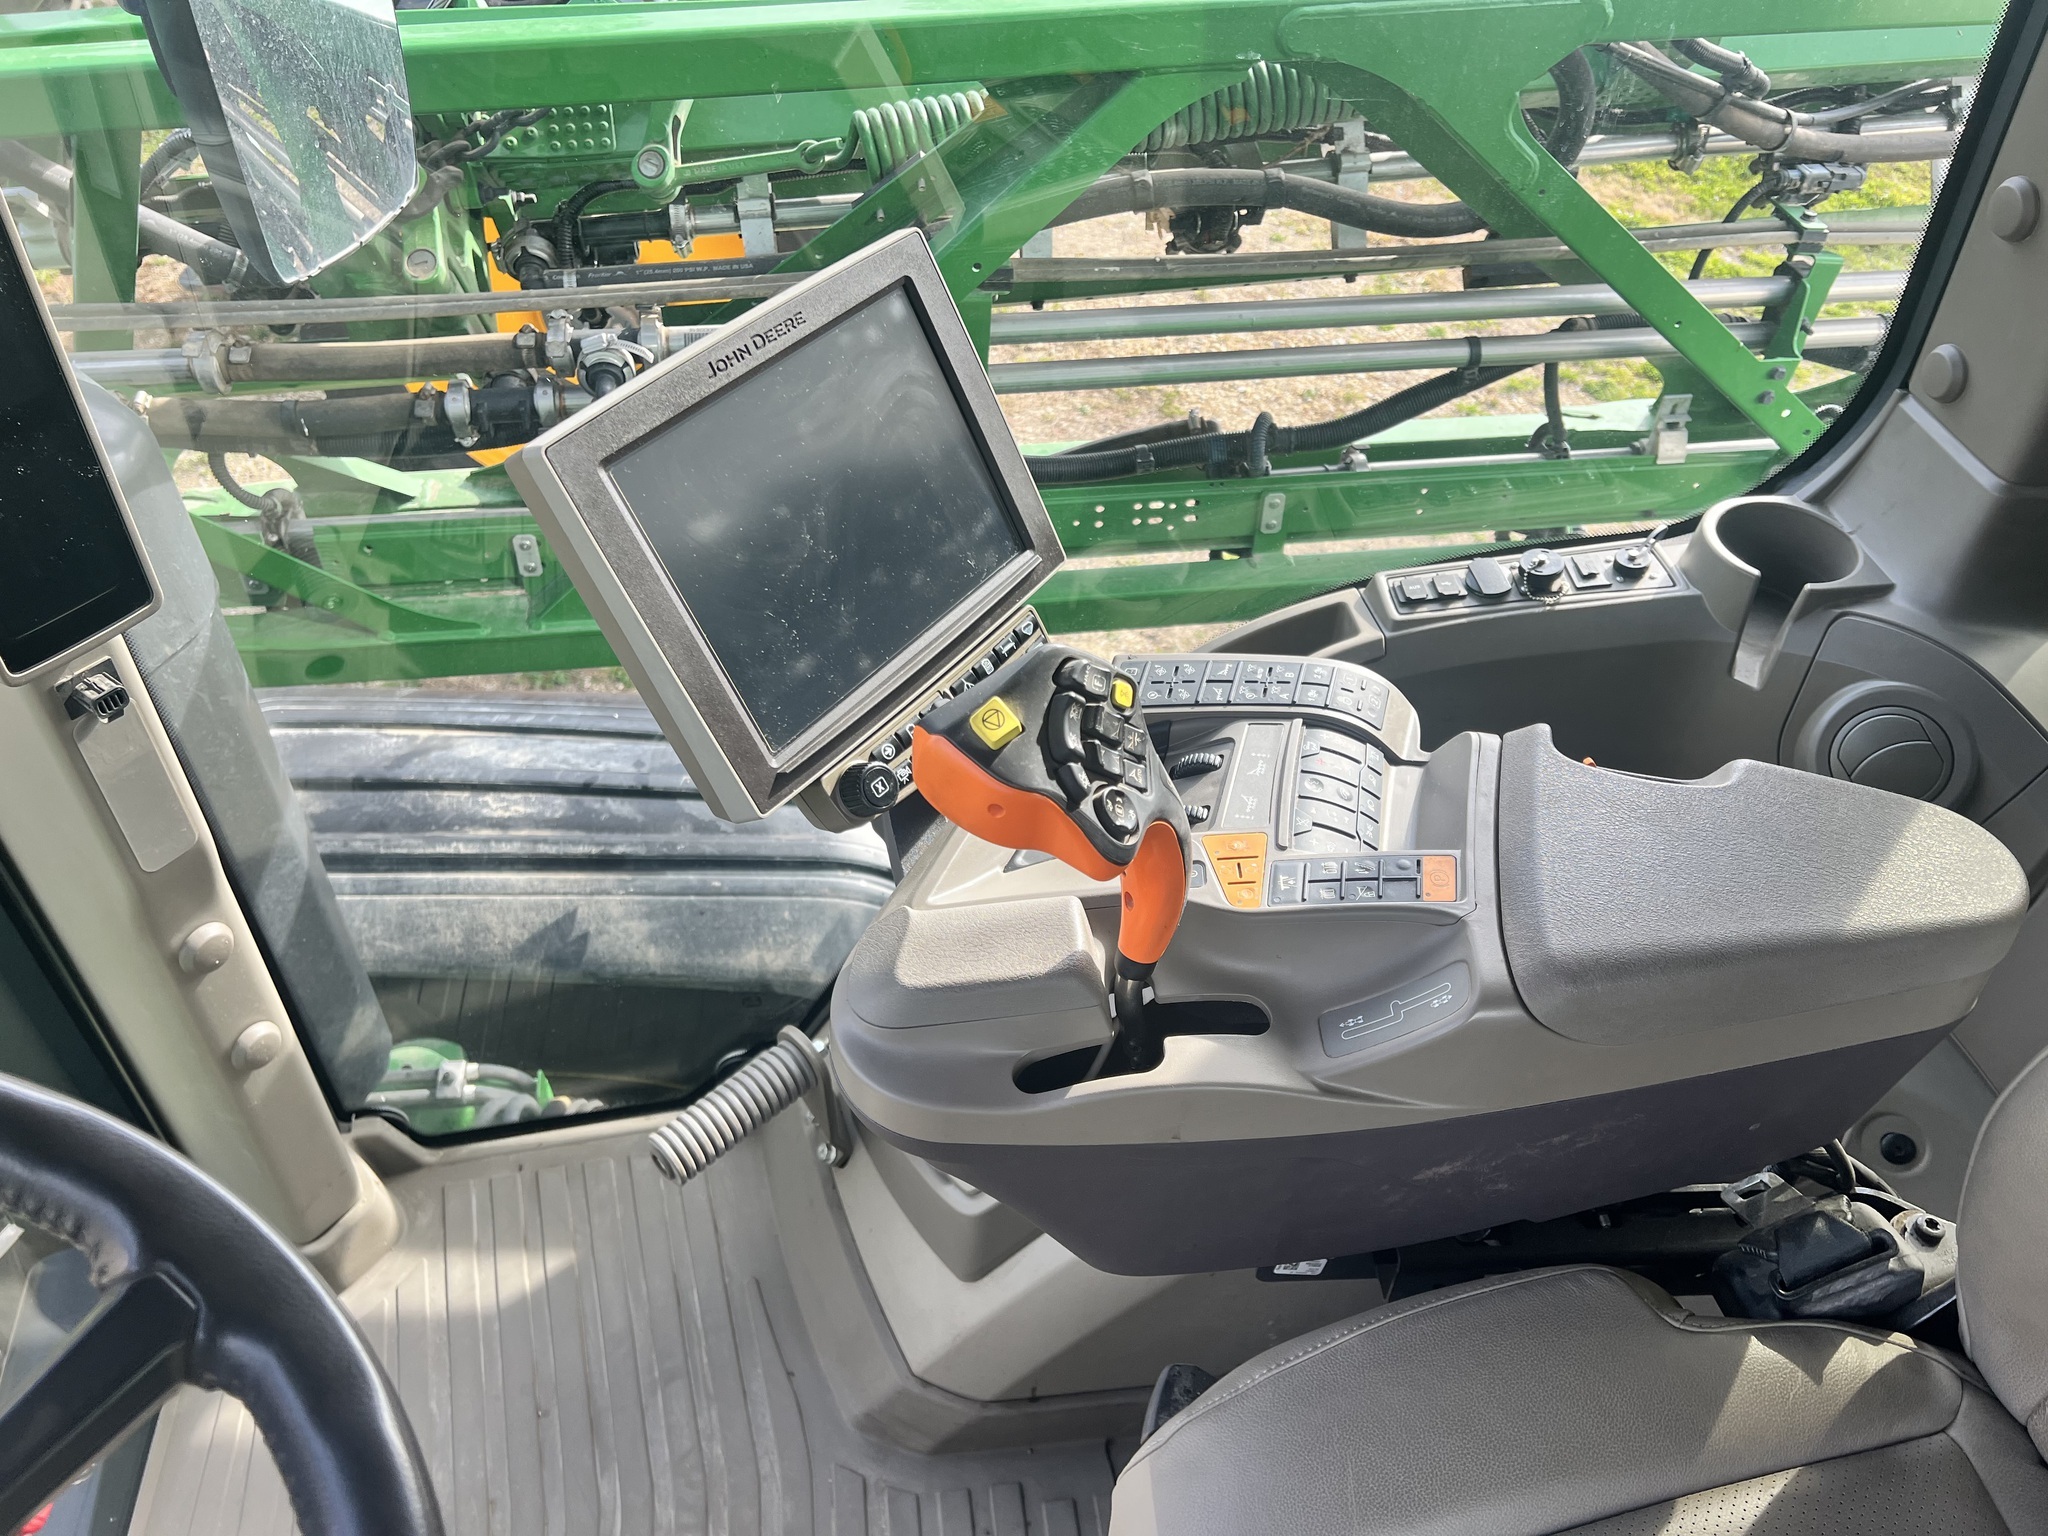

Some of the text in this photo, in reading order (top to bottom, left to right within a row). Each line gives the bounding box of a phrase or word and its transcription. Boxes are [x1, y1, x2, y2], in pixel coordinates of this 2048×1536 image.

[740, 262, 754, 270] USA
[708, 310, 807, 380] JOHN DEERE
[1093, 679, 1103, 688] F
[1278, 692, 1291, 700] A
